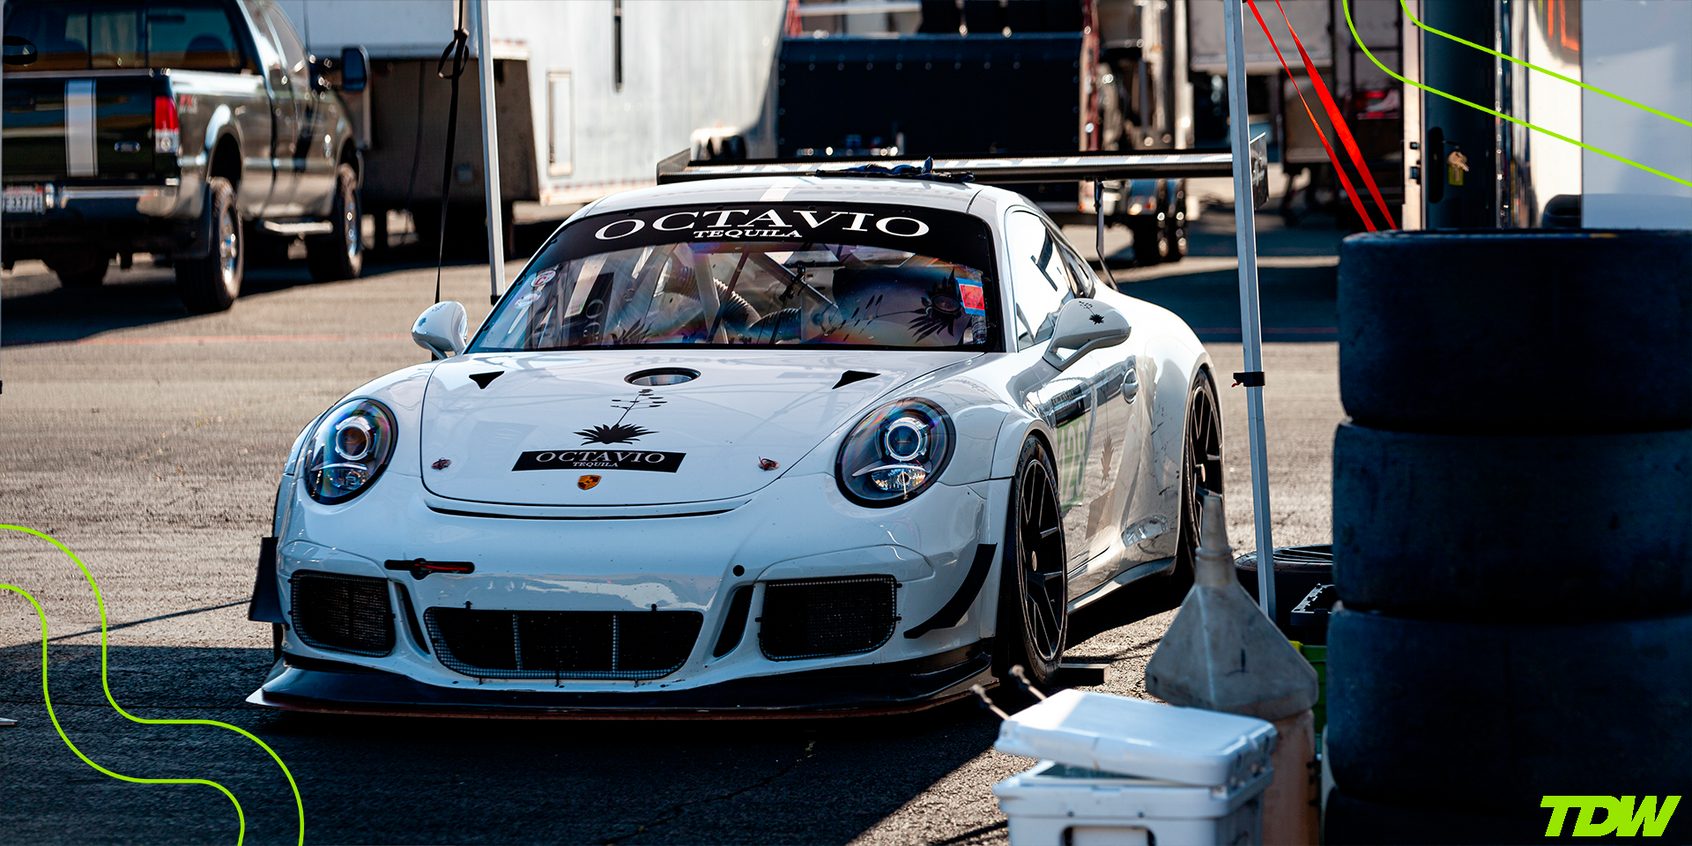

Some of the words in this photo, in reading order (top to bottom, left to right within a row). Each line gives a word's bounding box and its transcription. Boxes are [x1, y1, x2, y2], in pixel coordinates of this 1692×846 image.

[595, 208, 929, 240] OCTAVIO
[694, 228, 802, 239] TEQUILA
[536, 452, 665, 463] OCTAVIO
